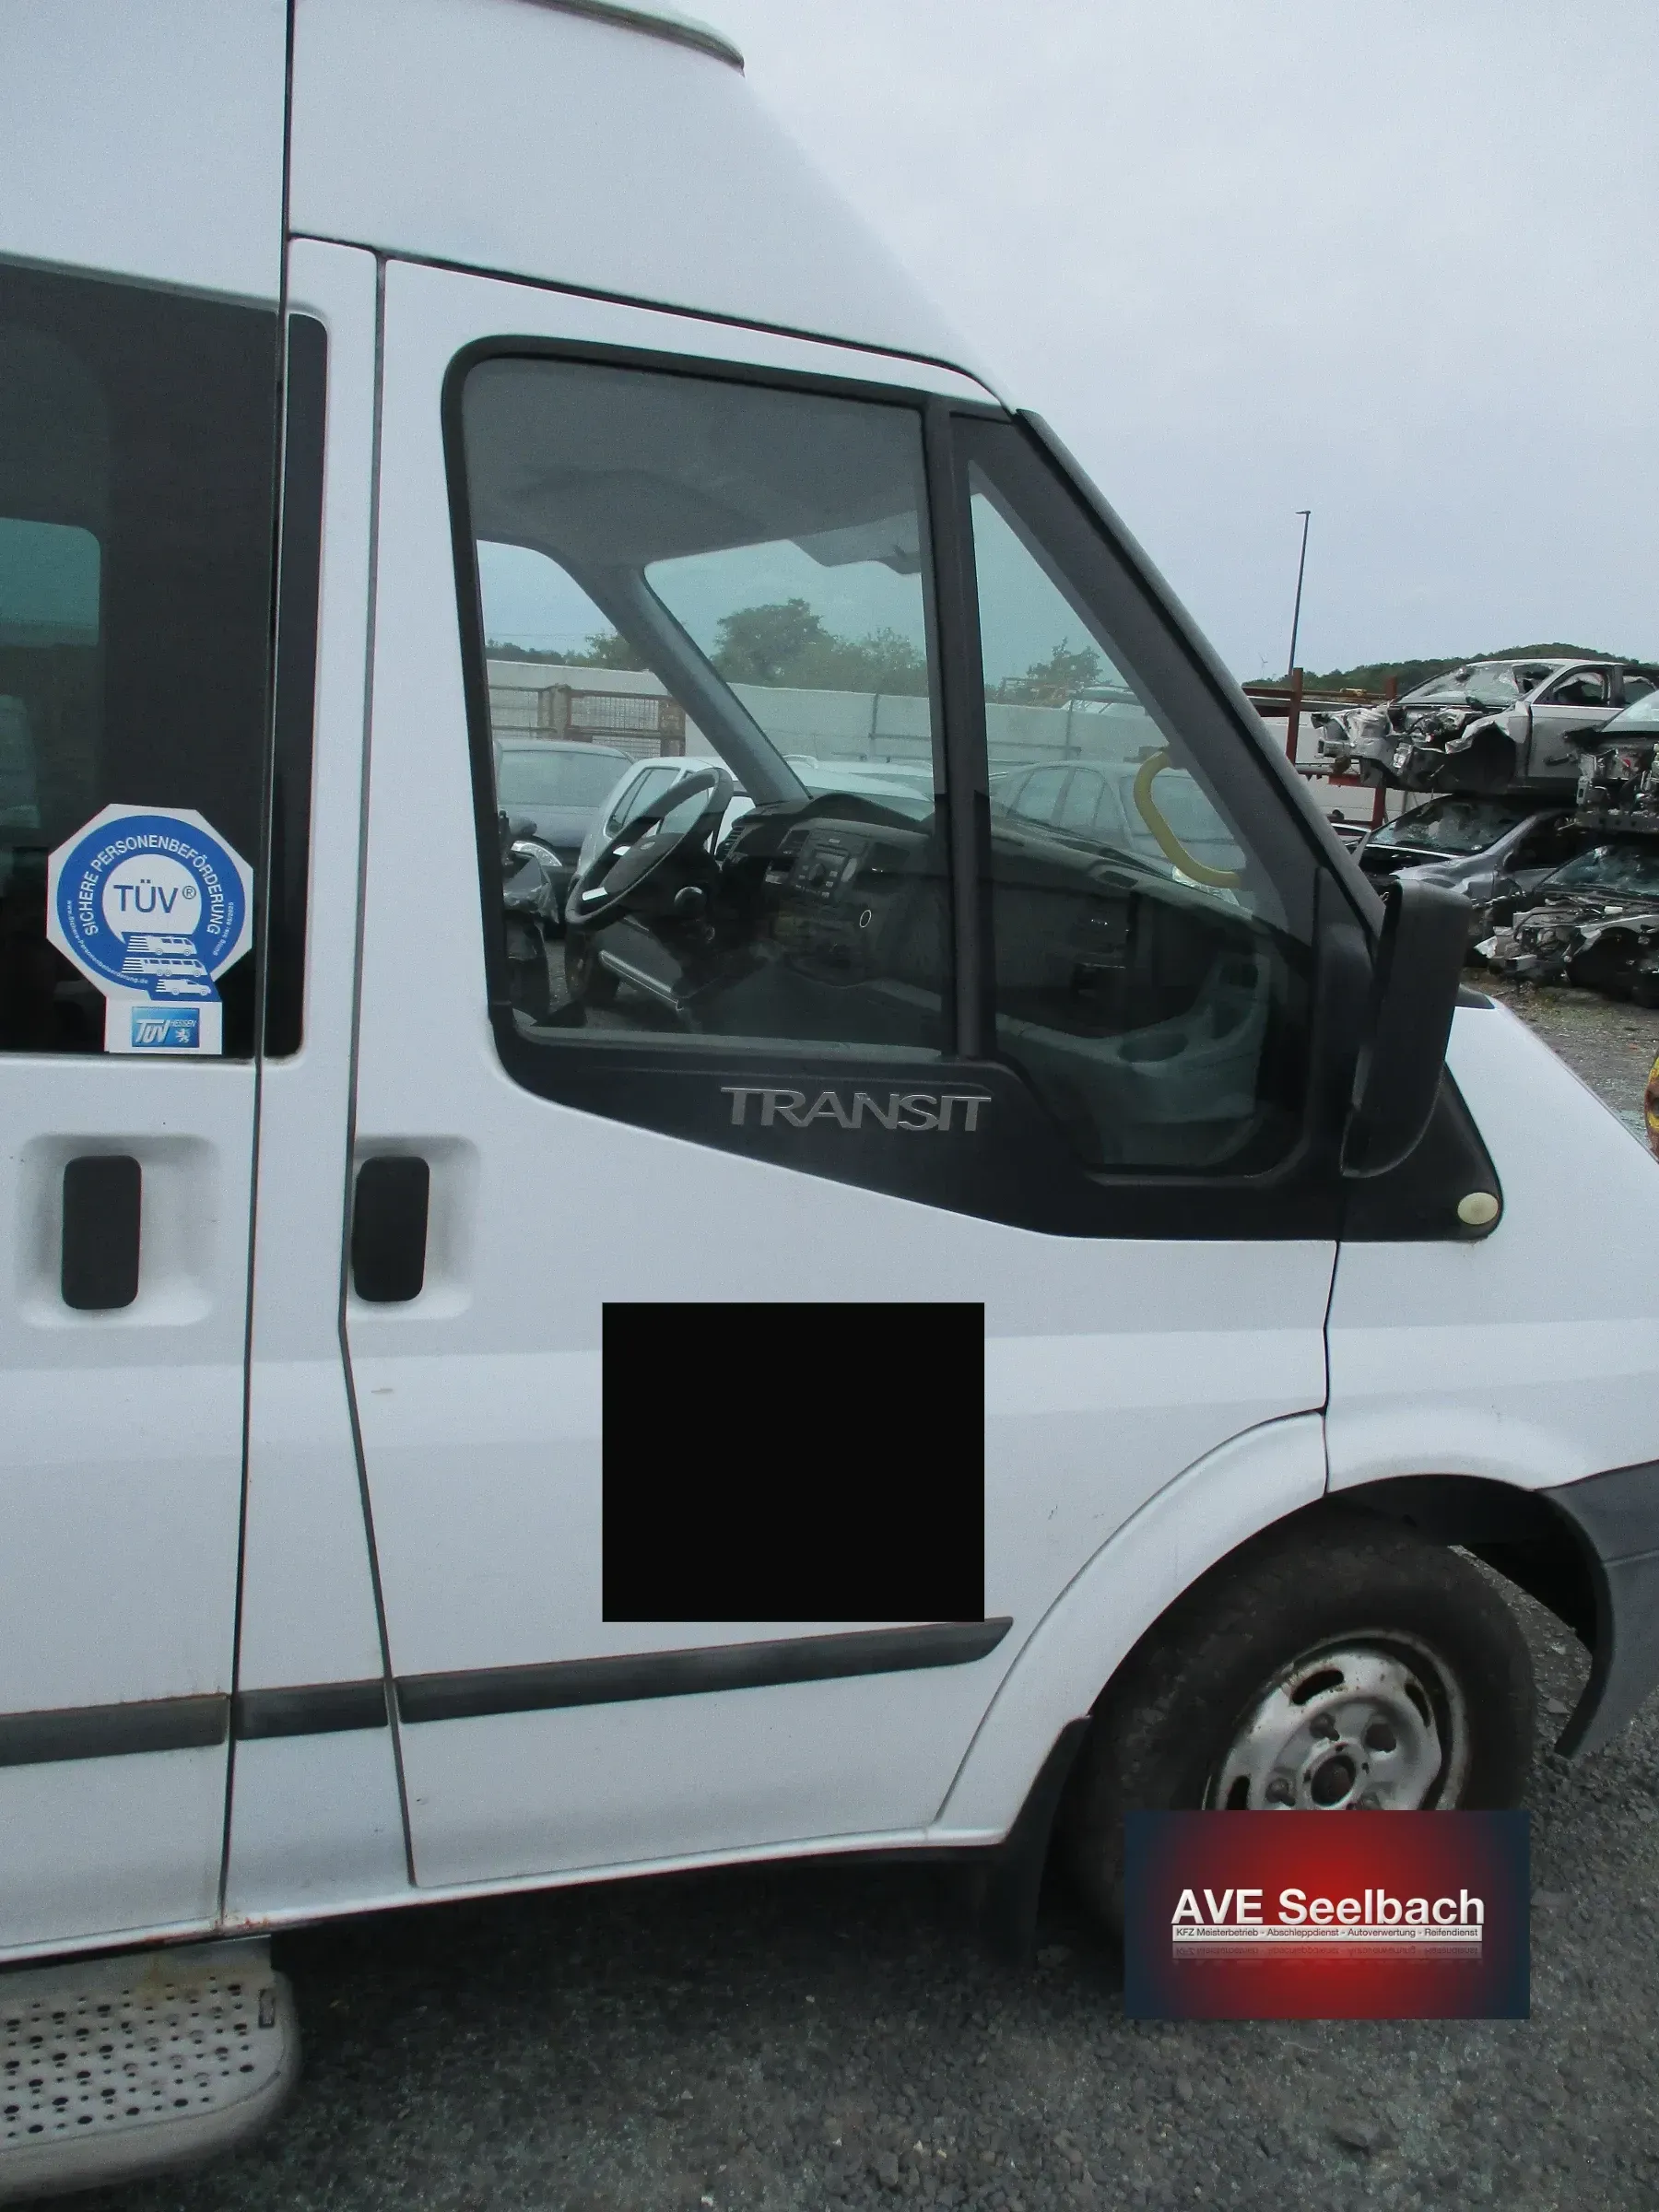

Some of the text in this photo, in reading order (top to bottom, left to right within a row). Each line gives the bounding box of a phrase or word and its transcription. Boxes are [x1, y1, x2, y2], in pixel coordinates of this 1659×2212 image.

[77, 834, 225, 936] SICHERE PERSONENBEFÖRDERUNG
[170, 1019, 196, 1028] HESSEN
[721, 1087, 992, 1132] TRANSIT
